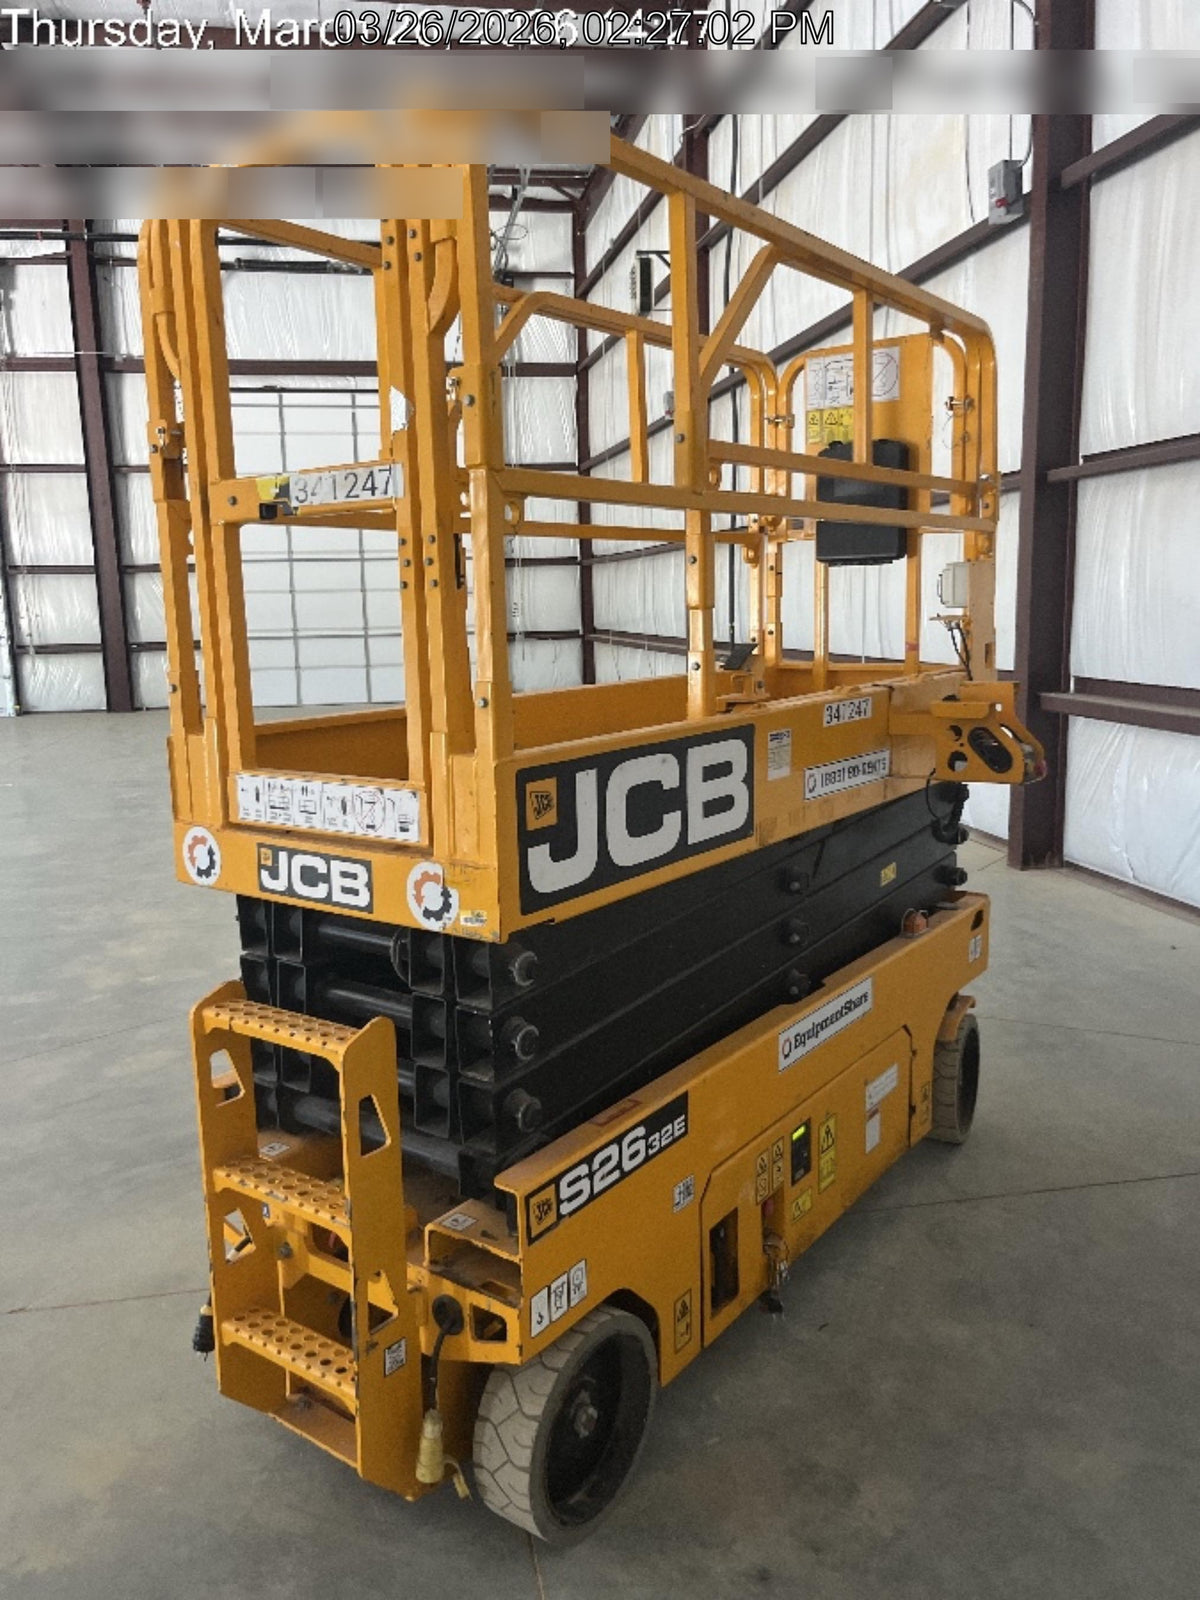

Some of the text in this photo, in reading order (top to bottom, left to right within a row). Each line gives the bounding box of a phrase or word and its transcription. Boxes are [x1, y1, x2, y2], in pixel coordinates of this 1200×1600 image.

[294, 464, 392, 503] 341247
[528, 738, 750, 894] JCB
[261, 851, 371, 908] JCB
[793, 991, 870, 1050] EquipmentShare
